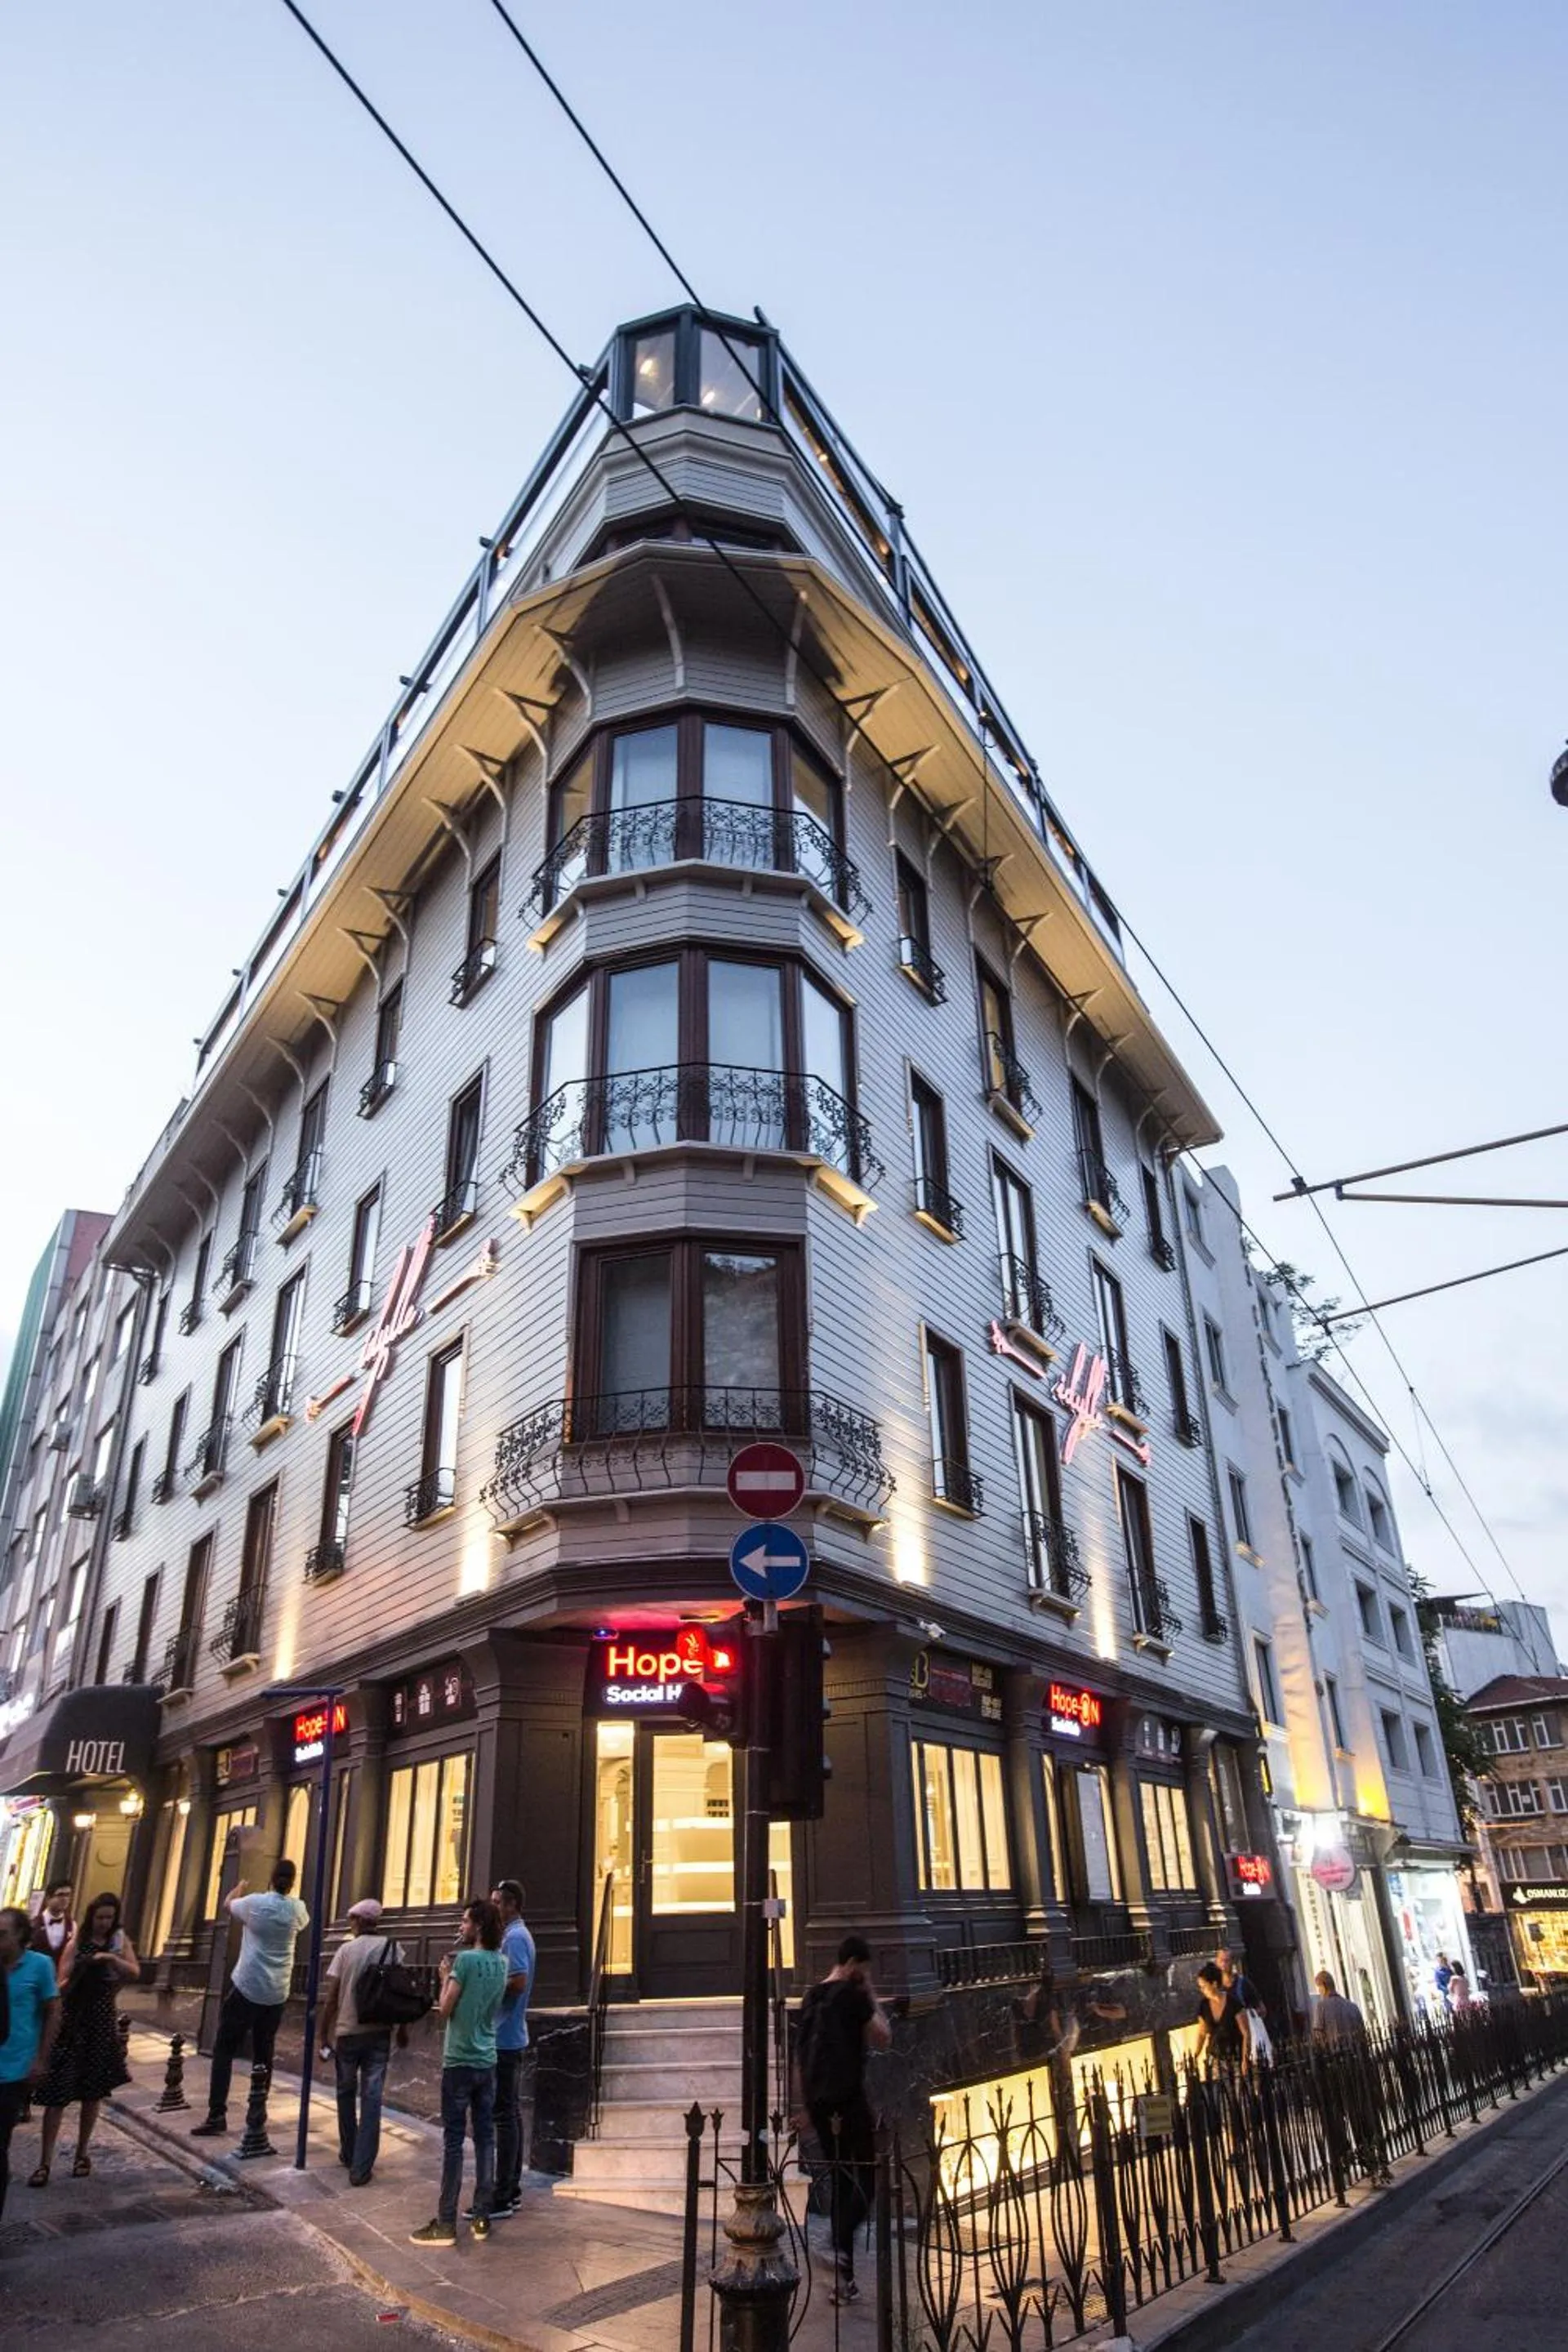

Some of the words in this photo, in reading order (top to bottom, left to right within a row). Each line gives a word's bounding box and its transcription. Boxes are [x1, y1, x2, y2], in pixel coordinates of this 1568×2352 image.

[608, 1646, 705, 1683] Hope
[606, 1684, 664, 1703] Social
[296, 1705, 346, 1743] Hope-N
[65, 1740, 127, 1774] HOTEL
